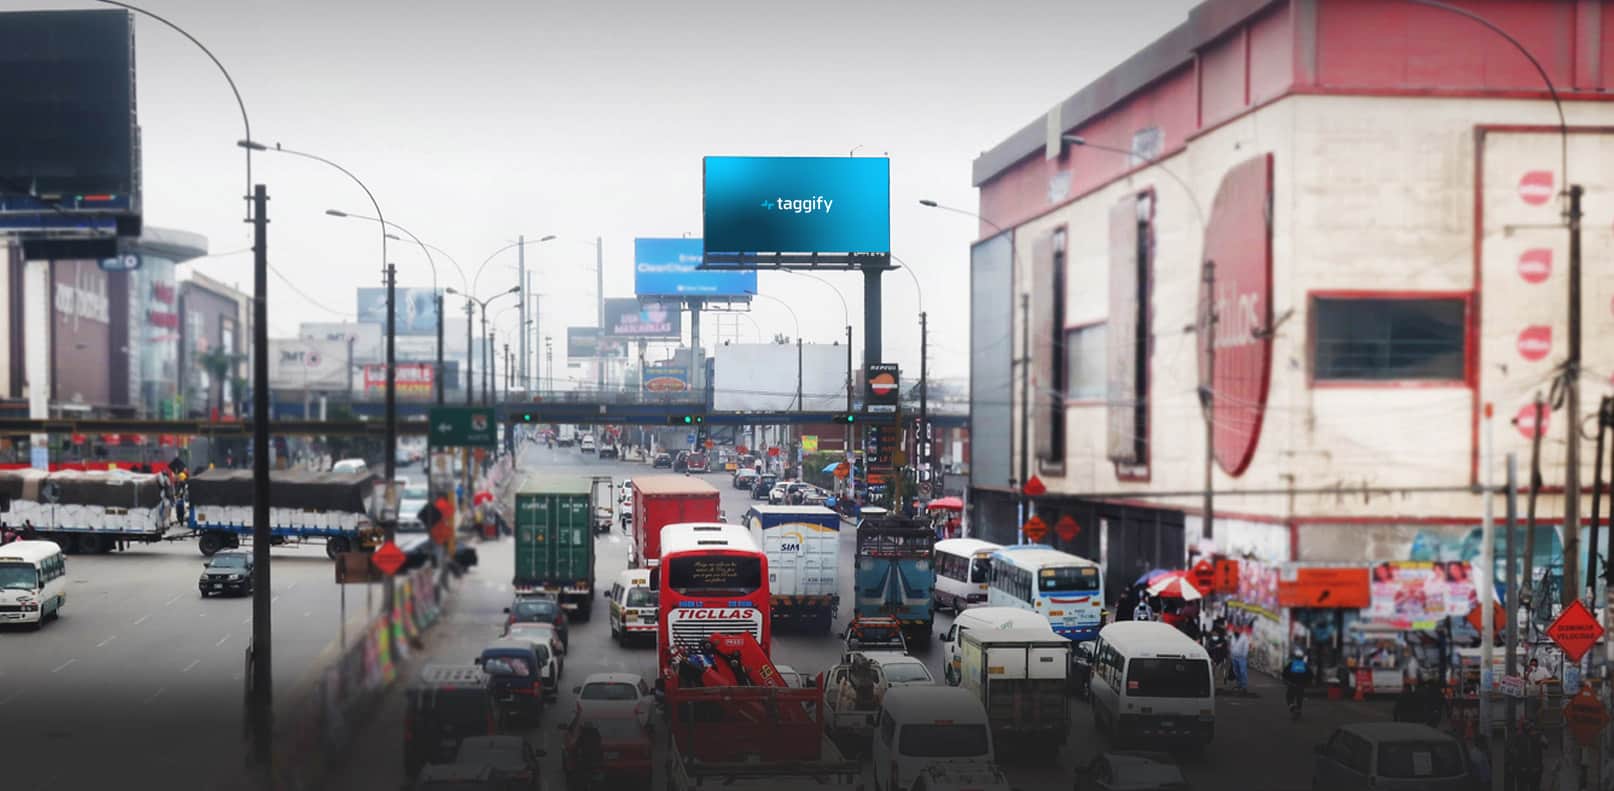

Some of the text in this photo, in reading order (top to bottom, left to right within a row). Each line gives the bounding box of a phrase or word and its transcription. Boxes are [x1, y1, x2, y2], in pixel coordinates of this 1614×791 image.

[776, 195, 834, 213] taggify
[781, 543, 800, 552] SIM
[677, 609, 755, 620] TICLLAS
